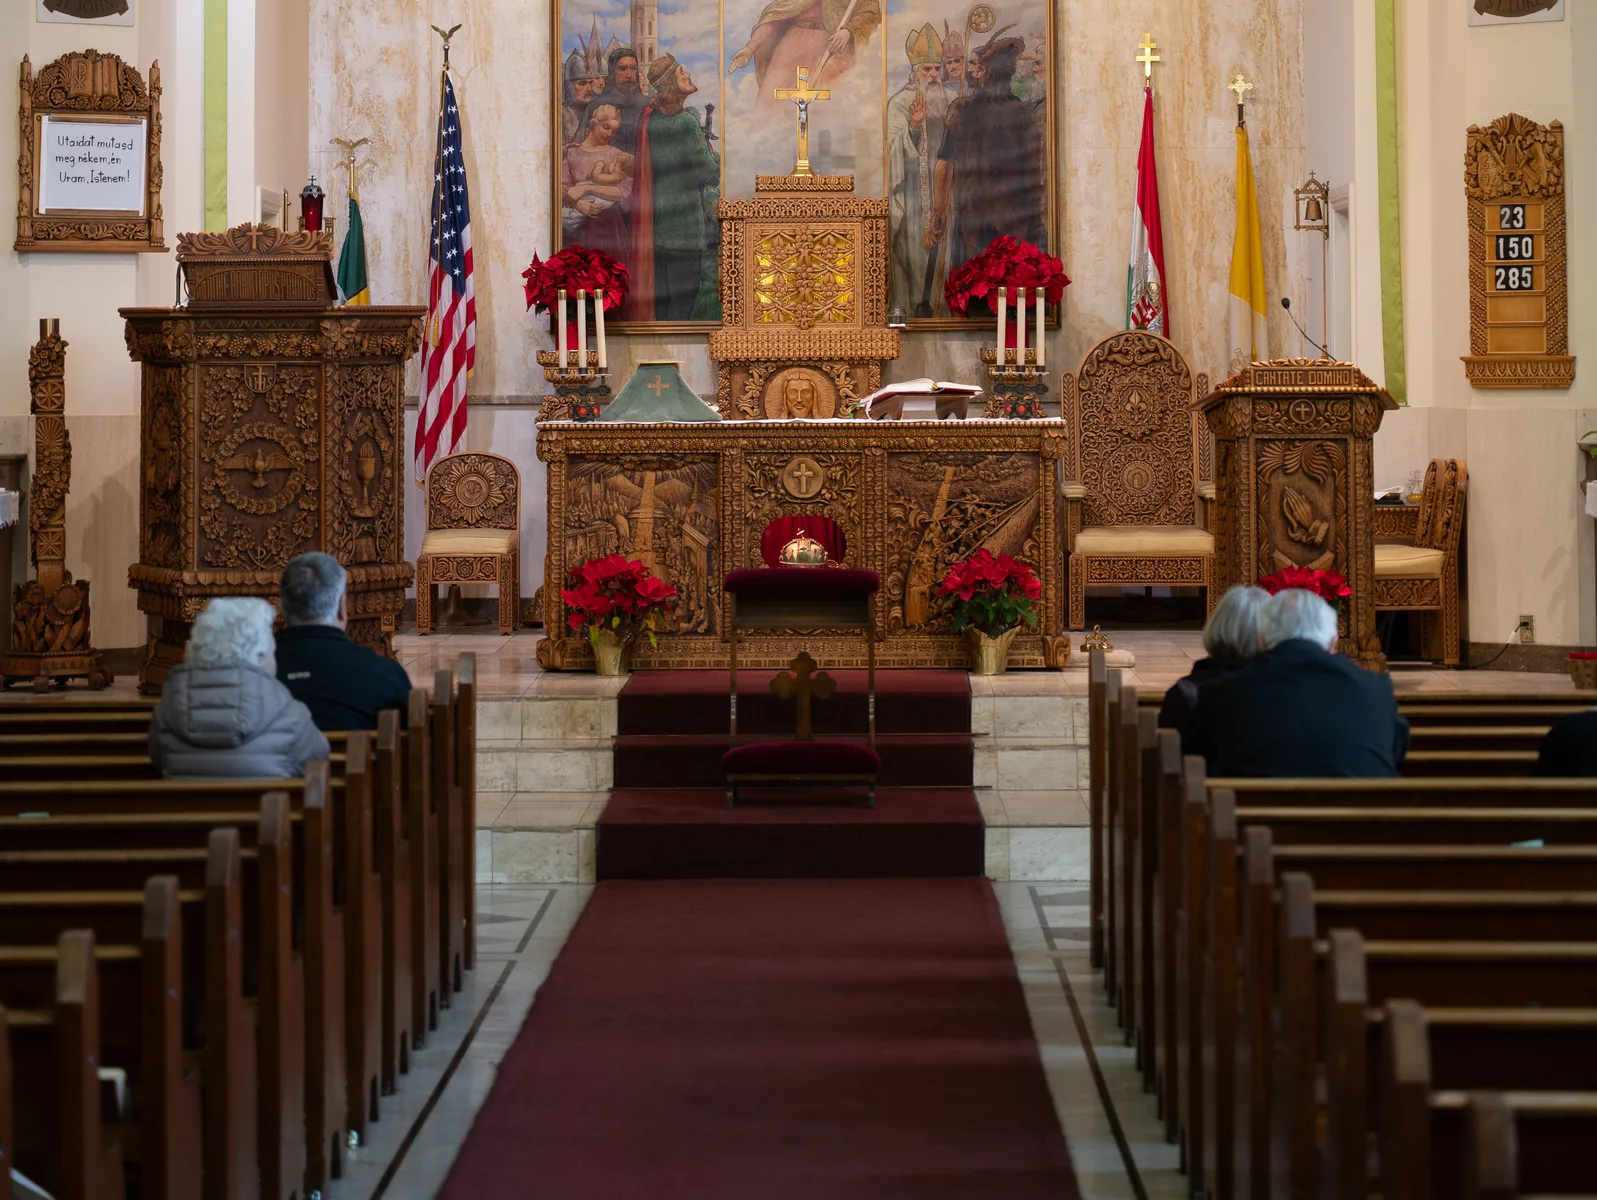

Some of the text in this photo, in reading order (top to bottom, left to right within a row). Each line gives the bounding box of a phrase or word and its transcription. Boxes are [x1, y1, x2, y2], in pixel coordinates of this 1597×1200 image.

[57, 135, 134, 150] Utaidat mutasd
[55, 154, 75, 167] meg
[59, 169, 130, 184] Uram, Istenem!
[1500, 206, 1524, 228] 23
[1497, 236, 1532, 259] 150
[1495, 266, 1532, 290] 285
[1255, 370, 1350, 385] CANTATE DOMINO
